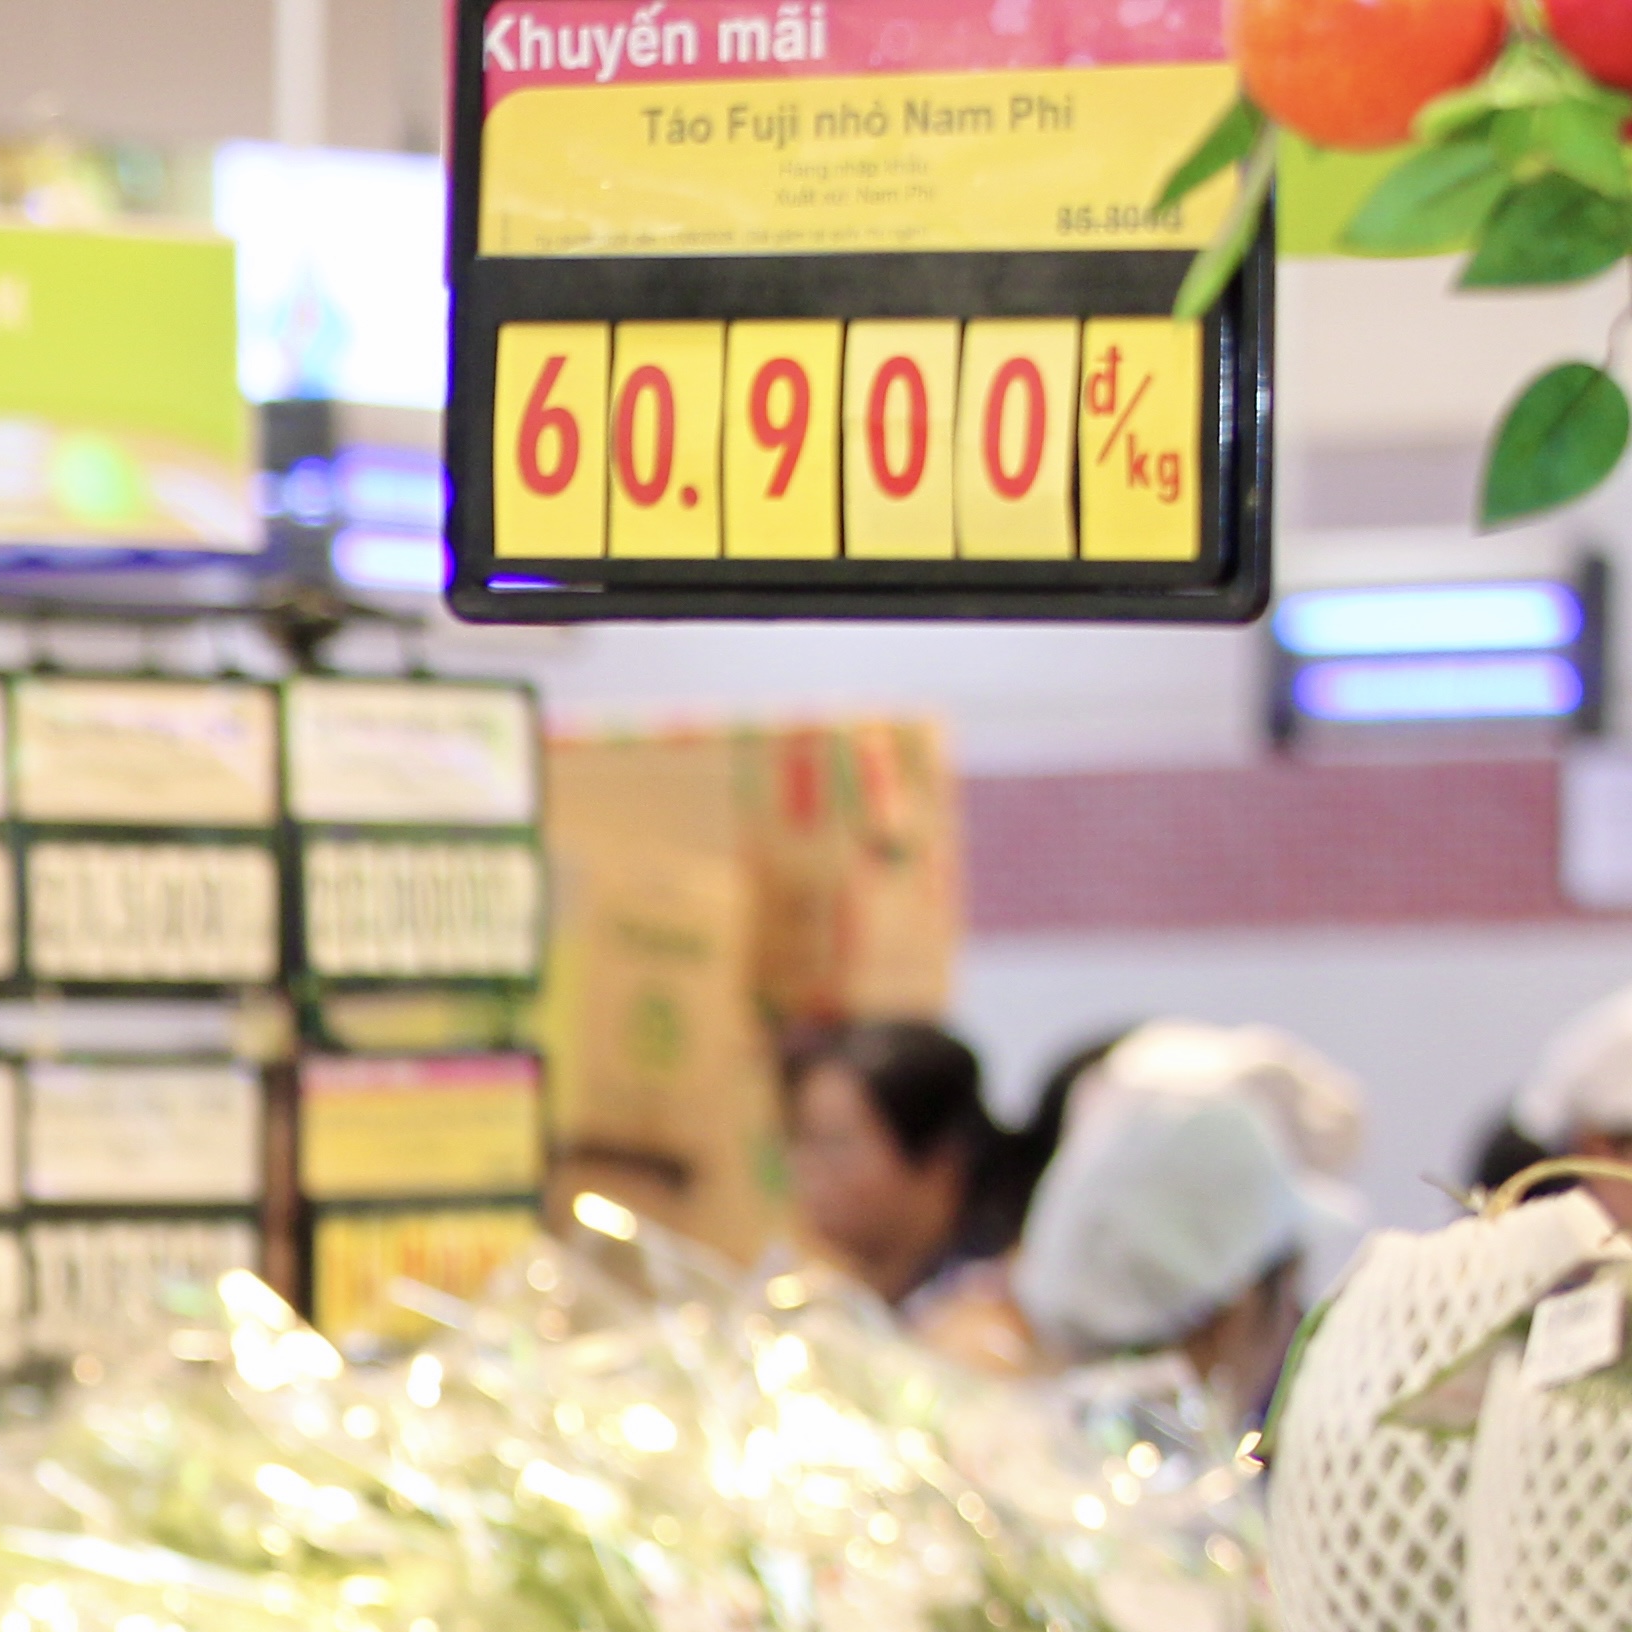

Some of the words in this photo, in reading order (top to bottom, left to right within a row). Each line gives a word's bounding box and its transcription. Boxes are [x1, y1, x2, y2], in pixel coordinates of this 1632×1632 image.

[482, 0, 699, 83] Khuyến
[716, 3, 826, 64] mãi
[725, 104, 802, 149] Fuji
[903, 97, 995, 137] Nam
[1008, 93, 1076, 134] Phi
[514, 352, 1049, 510] 60.900
